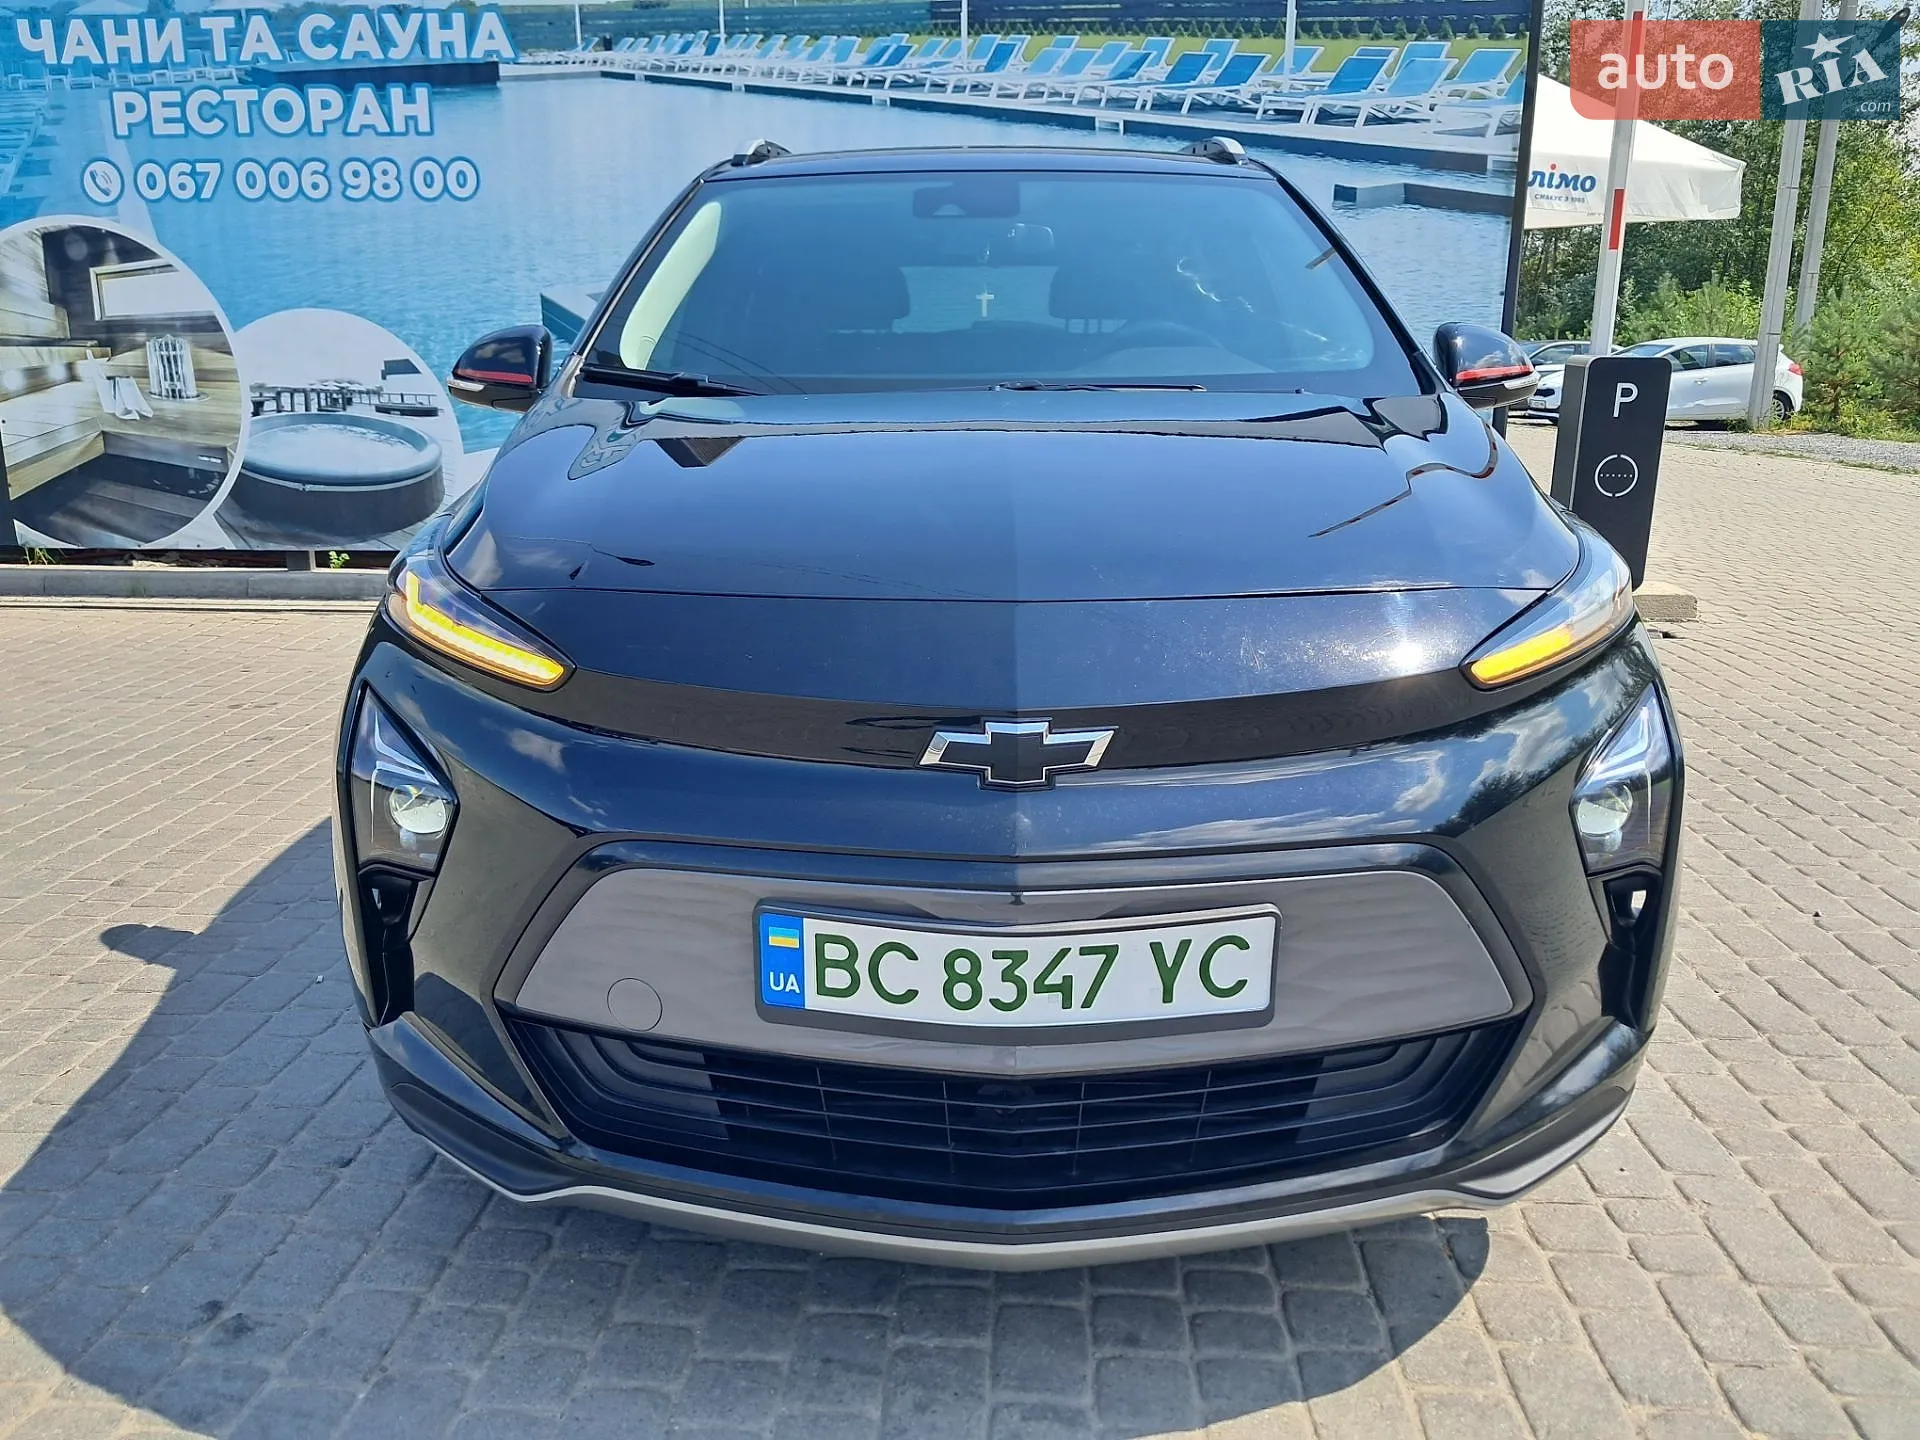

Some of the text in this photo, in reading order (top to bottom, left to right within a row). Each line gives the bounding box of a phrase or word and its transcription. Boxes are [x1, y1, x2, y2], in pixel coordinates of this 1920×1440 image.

[17, 12, 515, 65] ЧАНИ ТА САУНА
[112, 86, 433, 137] РЕСТОРАН
[136, 159, 478, 200] 067 006 98 00
[1612, 382, 1638, 418] P
[769, 932, 1252, 1013] UA BC 8347 YC
